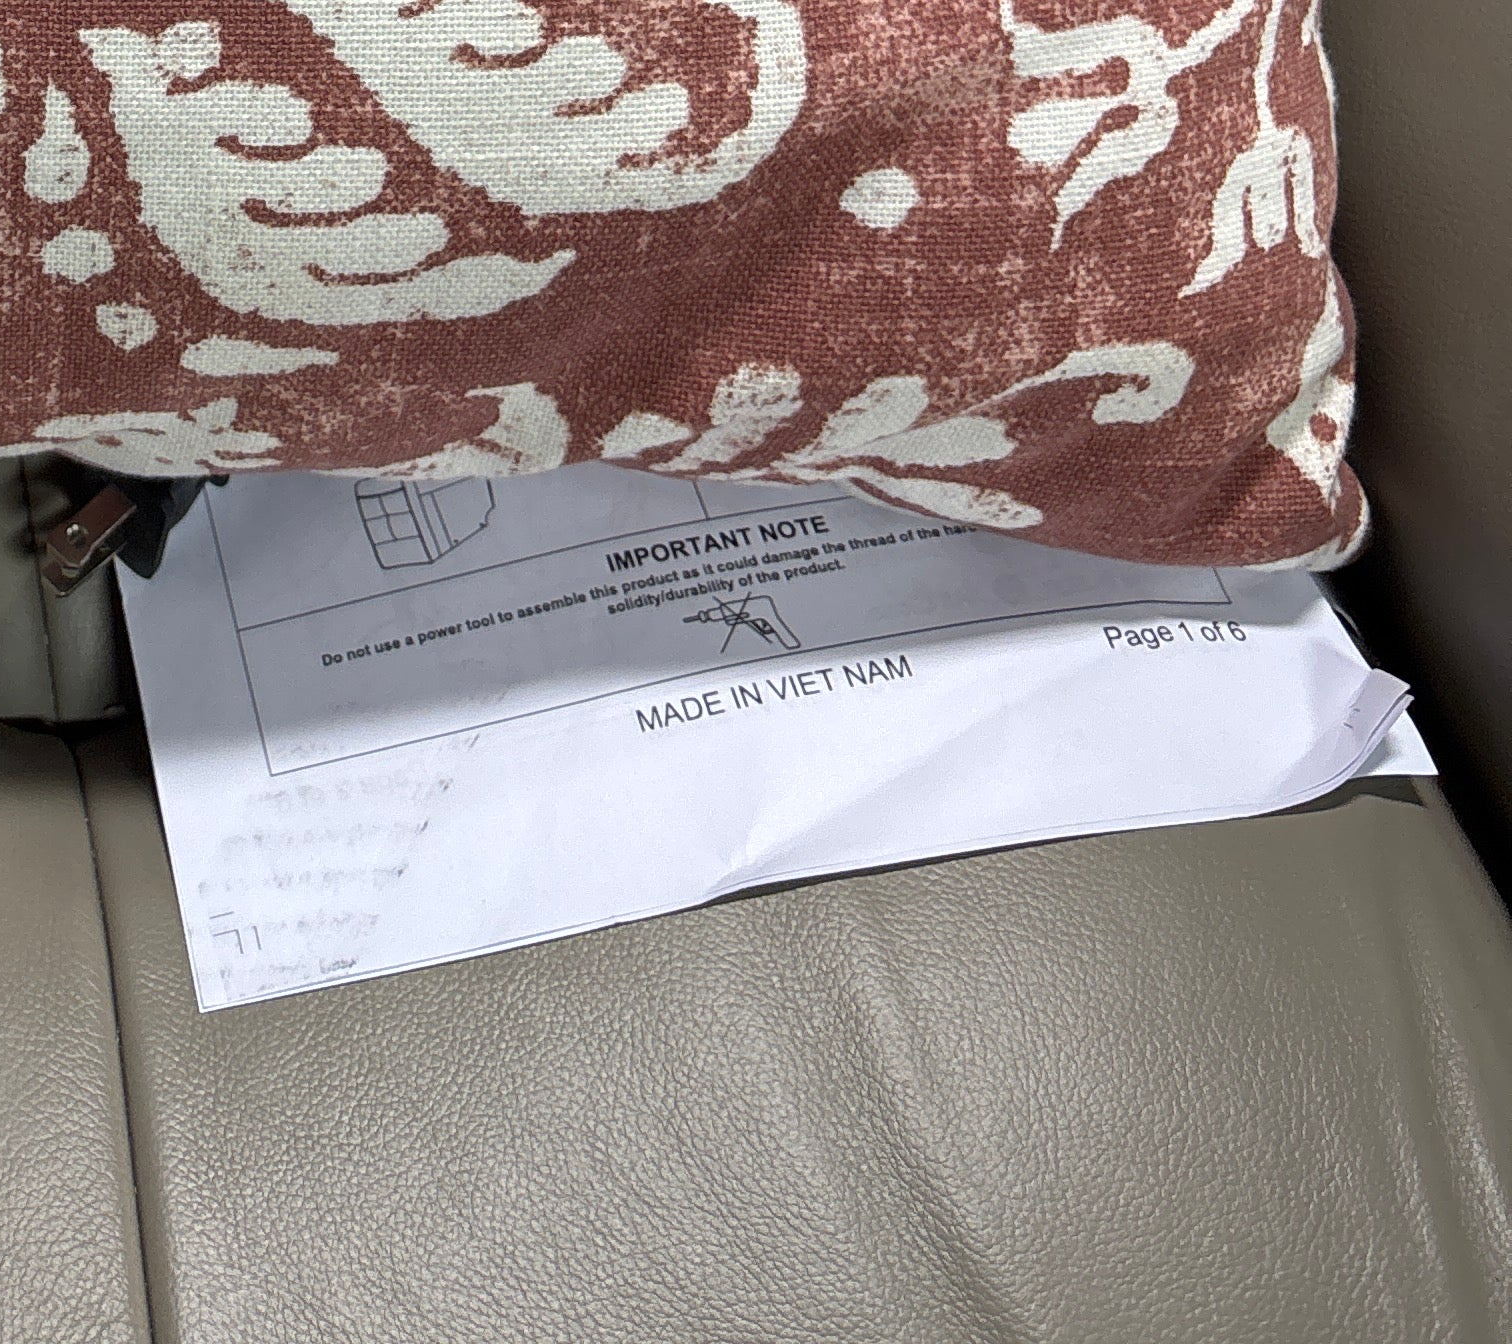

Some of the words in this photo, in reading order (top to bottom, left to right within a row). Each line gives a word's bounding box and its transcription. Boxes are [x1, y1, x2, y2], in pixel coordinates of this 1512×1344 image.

[605, 527, 751, 573] IMPORTANT
[757, 515, 830, 543] NOTE
[321, 653, 343, 666] Do
[347, 644, 371, 661] not
[374, 639, 401, 653] use
[405, 635, 414, 645] a
[418, 622, 463, 645] power
[465, 613, 496, 631] tool
[497, 611, 513, 623] to
[517, 592, 587, 618] assemble
[589, 584, 618, 600] this
[622, 570, 680, 598] product
[682, 567, 700, 580] as
[703, 563, 714, 575] it
[717, 555, 758, 573] could
[761, 546, 820, 564] damage
[821, 542, 846, 554] the
[848, 533, 897, 550] thread
[899, 529, 915, 543] of
[916, 527, 941, 539] the
[607, 578, 734, 614] solidity/durability
[739, 573, 753, 587] of
[755, 571, 780, 584] the
[783, 559, 846, 580] product.
[1103, 625, 1174, 649] Page
[1178, 621, 1194, 642] 1
[1200, 621, 1225, 642] of
[1227, 620, 1247, 642] 6
[635, 691, 726, 732] MADE
[730, 682, 763, 709] IN
[766, 668, 834, 700] VIET
[842, 655, 913, 688] NAM
